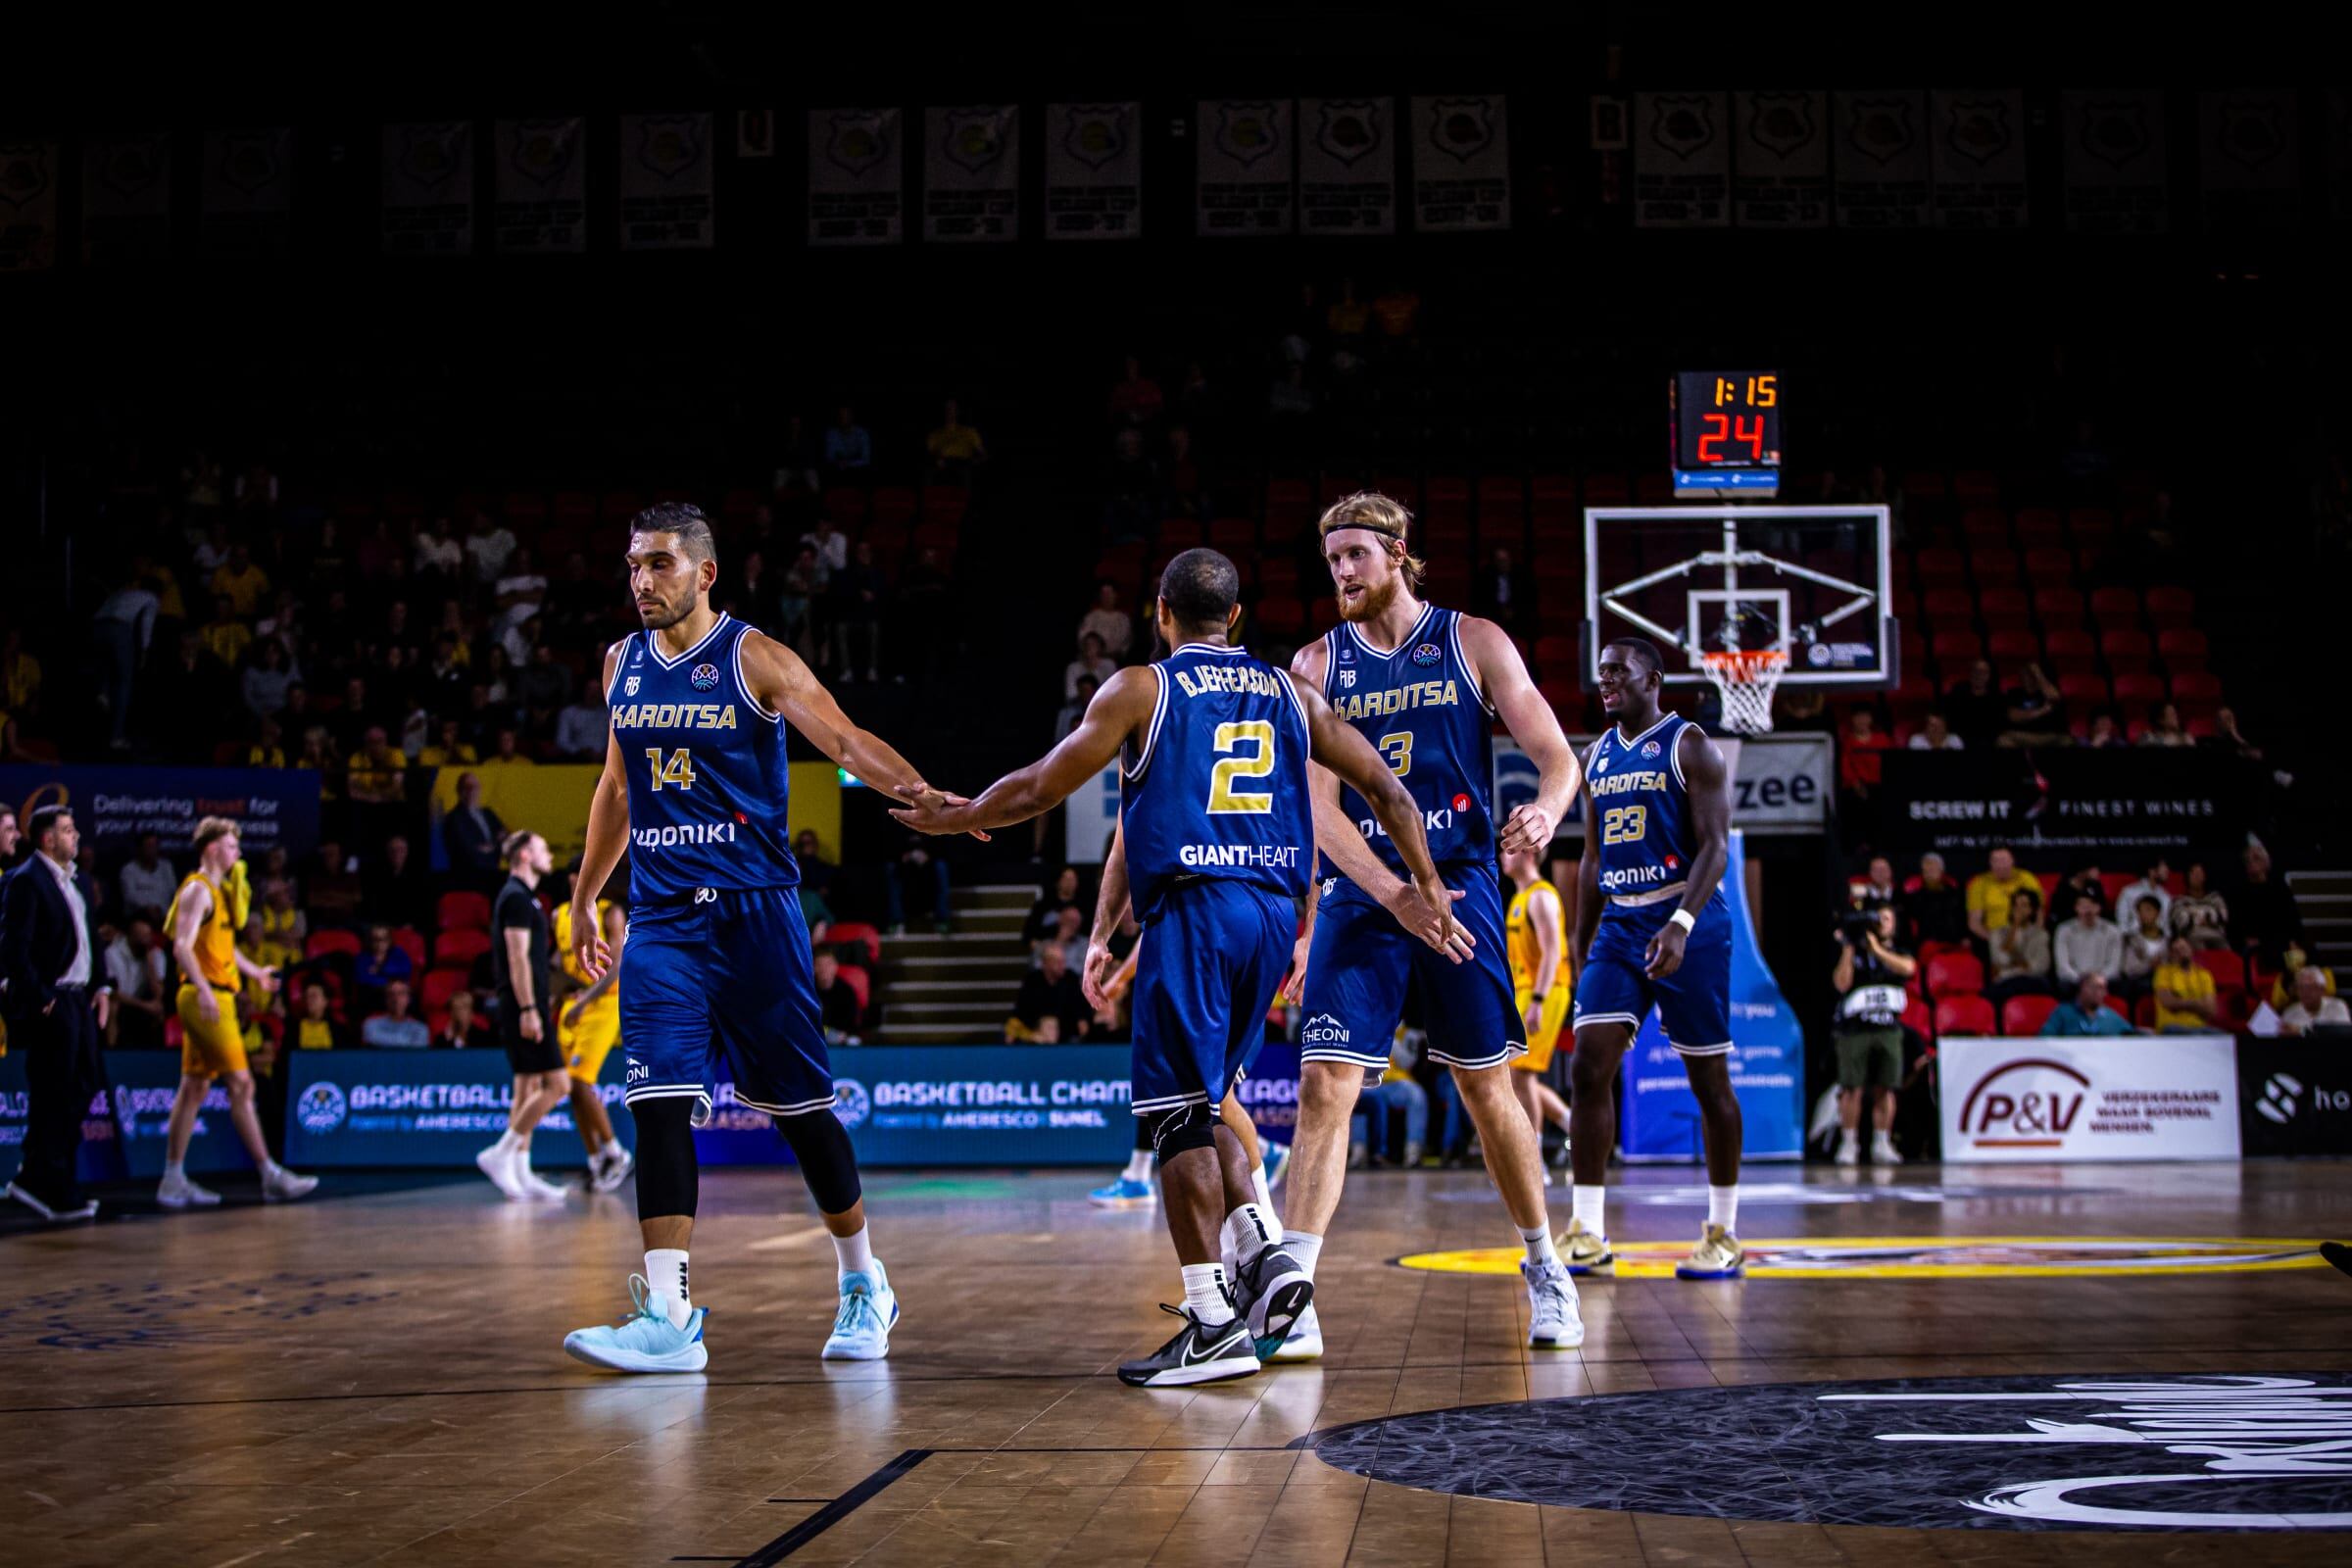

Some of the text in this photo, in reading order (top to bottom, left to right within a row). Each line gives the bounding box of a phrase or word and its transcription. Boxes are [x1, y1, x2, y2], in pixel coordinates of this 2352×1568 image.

[1715, 376, 1777, 407] 1:15
[1697, 413, 1764, 462] 24
[1334, 680, 1458, 721] KARDITSA
[612, 704, 737, 729] KARDITSA
[1206, 720, 1275, 814] 2
[1379, 731, 1413, 777] 3
[646, 748, 696, 791] 14
[1590, 771, 1667, 798] KARDITSA
[94, 795, 194, 816] Delivering
[249, 797, 279, 813] for
[1909, 799, 2214, 819] SCREW IT FINEST WINES
[1603, 806, 1647, 845] 23
[1180, 845, 1299, 867] GIANTHEAT
[627, 1065, 649, 1083] ONI
[350, 1084, 513, 1108] BASKETBALL
[874, 1081, 1047, 1105] BASKETBALL
[1978, 1091, 2084, 1134] P&V
